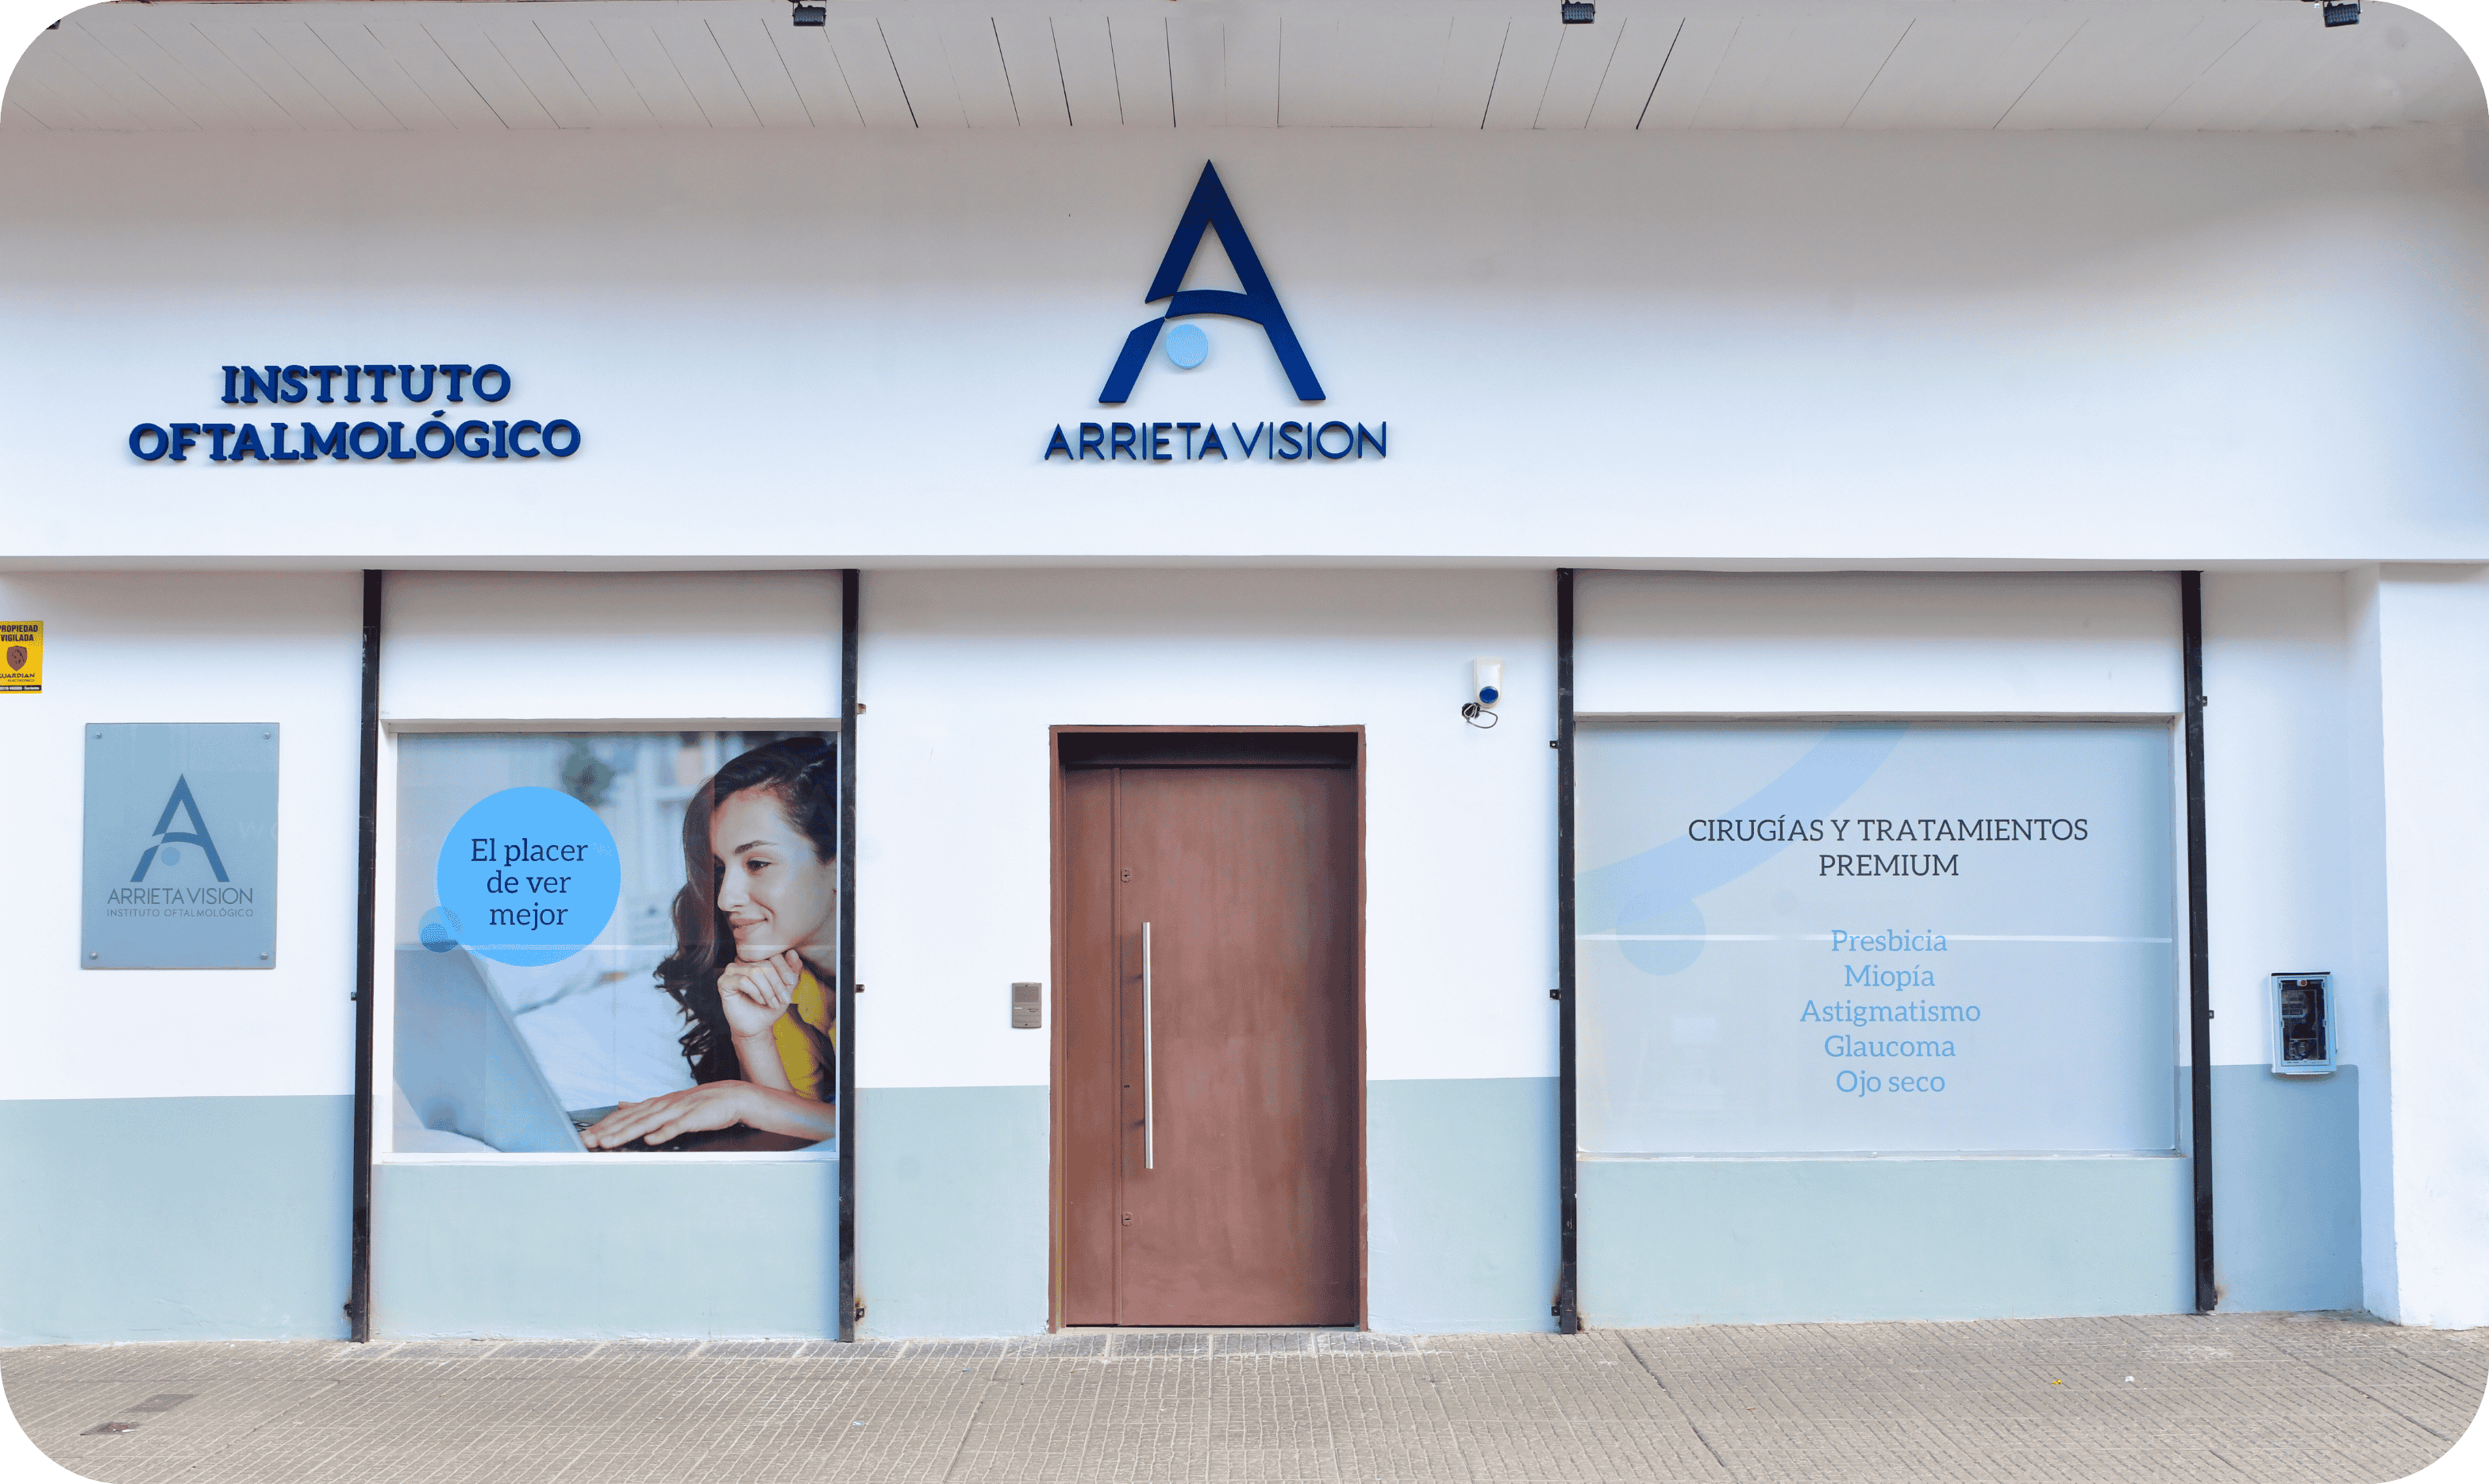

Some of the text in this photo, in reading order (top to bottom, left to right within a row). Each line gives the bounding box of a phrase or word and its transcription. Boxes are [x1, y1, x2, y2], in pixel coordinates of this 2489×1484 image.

[221, 364, 511, 404] INSTITUTO
[129, 409, 582, 461] OFTALMOLÓGICO
[1688, 814, 2089, 842] CIRUGÍAS Y TRATAMIENTOS
[471, 838, 590, 867] El placer
[1819, 854, 1960, 877] PREMIUM
[487, 870, 572, 894] de ver
[106, 907, 255, 917] INSTITUTO OFTALMOLÓGICO
[489, 902, 570, 932] mejor
[1830, 928, 1948, 952] Presbicia
[1844, 964, 1936, 992] Miopía
[1799, 999, 1981, 1028] Astigmatismo
[1823, 1035, 1956, 1058] Glaucoma
[1836, 1070, 1946, 1098] Ojo seco
